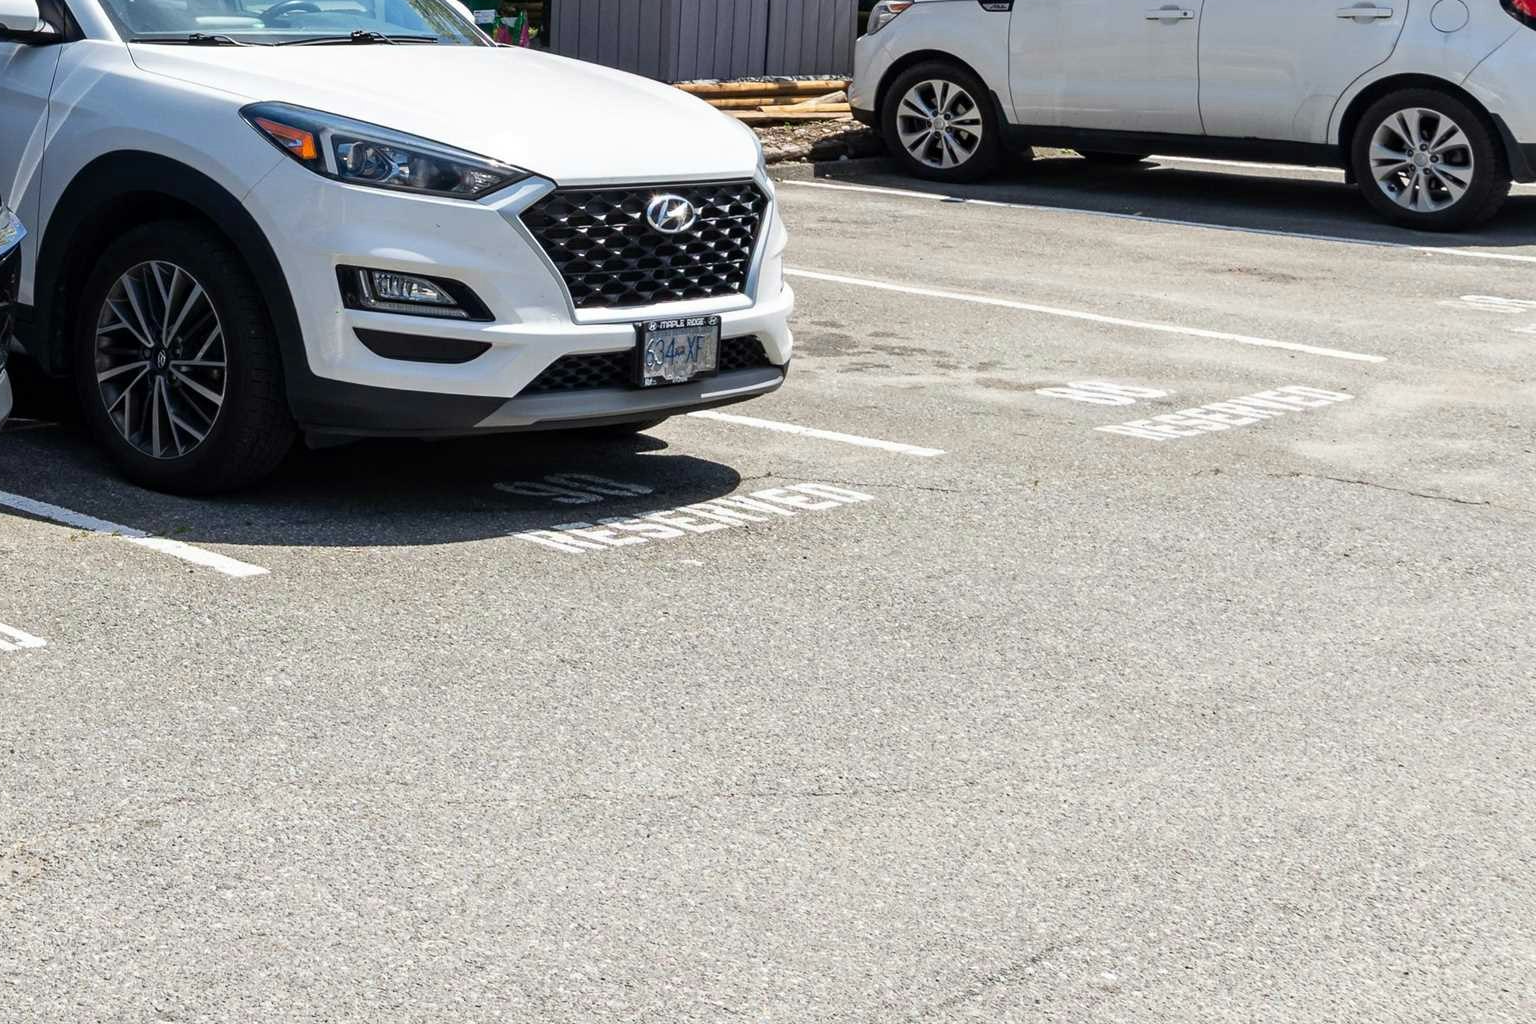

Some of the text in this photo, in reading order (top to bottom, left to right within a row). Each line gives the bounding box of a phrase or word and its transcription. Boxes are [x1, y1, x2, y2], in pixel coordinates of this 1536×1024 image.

[659, 318, 705, 329] MAPLE RIDGE
[1092, 385, 1356, 442] RESERVED
[506, 482, 876, 554] RESERVED
